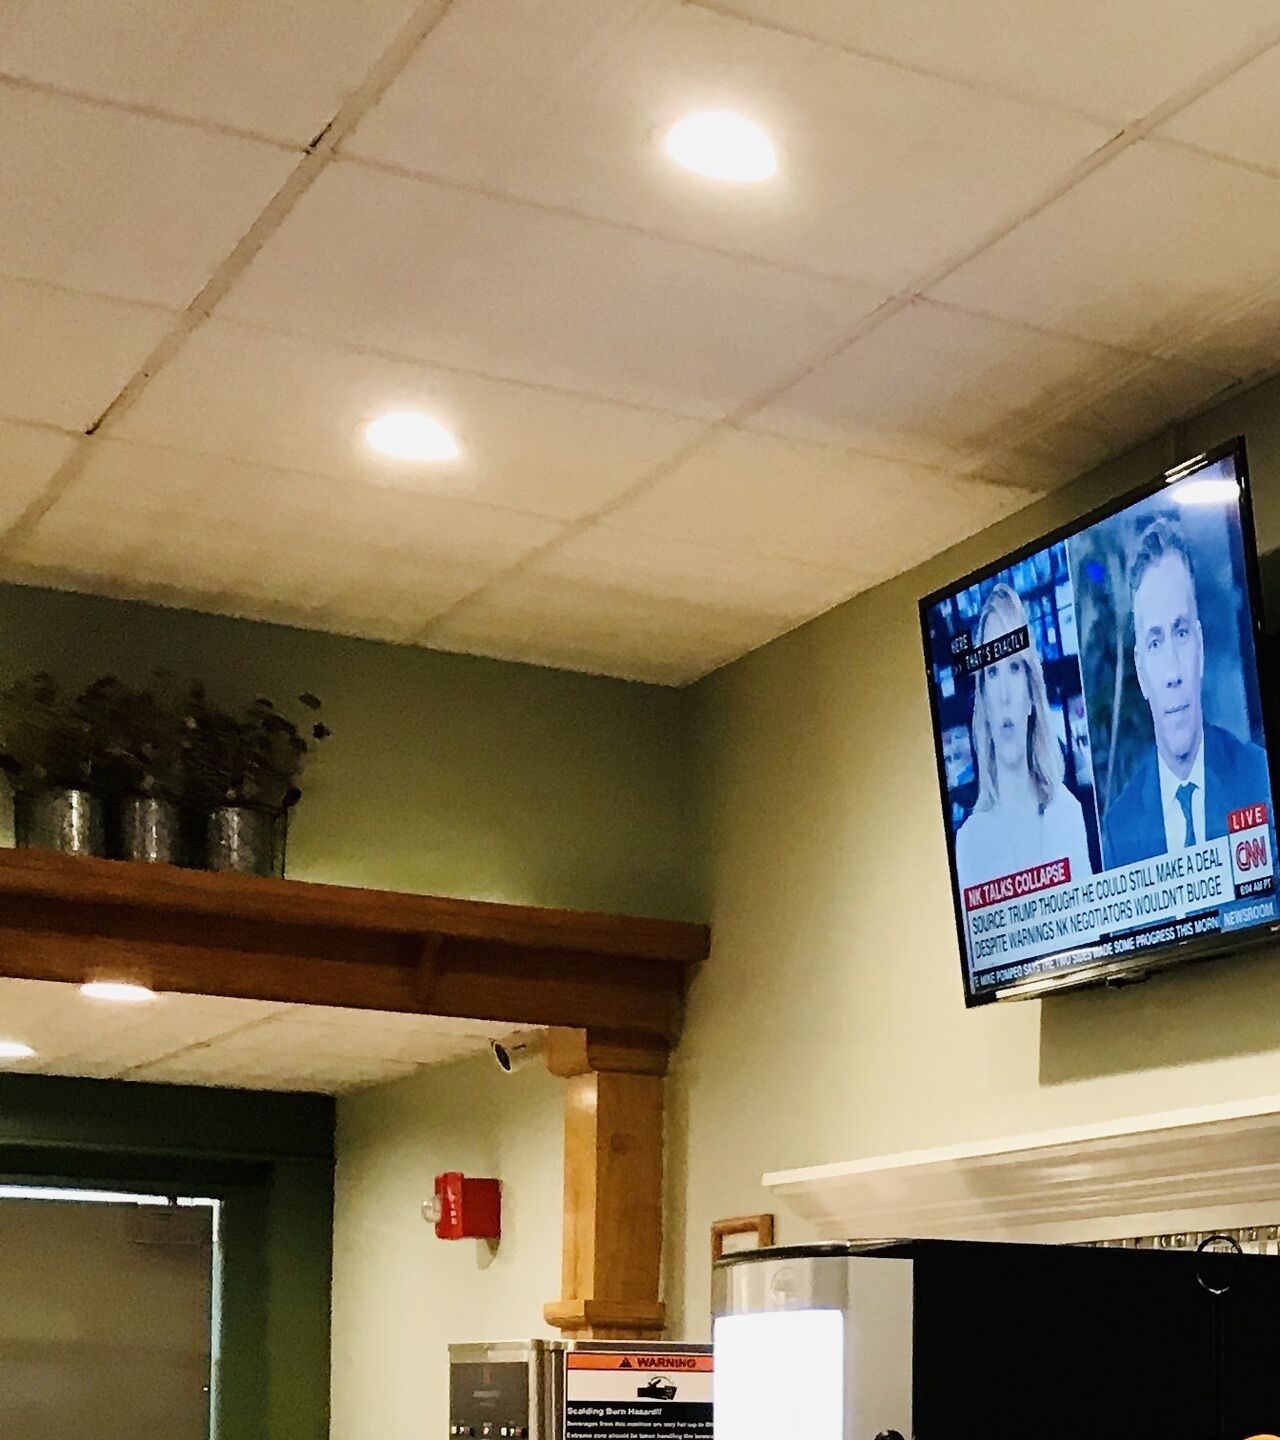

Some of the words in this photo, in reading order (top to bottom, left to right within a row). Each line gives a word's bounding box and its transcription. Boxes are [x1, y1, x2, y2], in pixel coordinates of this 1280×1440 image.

[1231, 807, 1263, 830] LIVE
[1236, 836, 1267, 871] CNN
[968, 887, 982, 907] NK
[983, 878, 1014, 900] TALKS
[1015, 862, 1066, 894] COLLAPSE
[1008, 900, 1038, 925] TRUMP
[1038, 888, 1080, 915] THOUGHT
[1082, 884, 1095, 904] HE
[1096, 875, 1128, 900] COULD
[1129, 867, 1155, 891] STILL
[1156, 858, 1185, 882] MAKE
[1187, 855, 1195, 874] A
[1195, 847, 1223, 872] DEAL
[974, 933, 1008, 959] DESPITE
[1008, 920, 1055, 949] WARNINGS
[1055, 917, 1071, 937] NK
[1070, 899, 1133, 933] NEGOTIATORS
[1134, 885, 1184, 916] WOULDN'T
[1187, 875, 1222, 903] BUDGE
[1223, 902, 1274, 928] NEWSROOM
[980, 971, 997, 986] MIKE
[997, 965, 1023, 982] POMPEO
[1023, 960, 1041, 976] SAYS
[1041, 957, 1055, 971] THE
[1055, 954, 1071, 968] TWO
[1071, 949, 1092, 964] SIDES
[1093, 943, 1113, 958] MADE
[1114, 937, 1135, 954] SOME
[1135, 926, 1175, 949] PROGRESS
[1176, 921, 1194, 938] THIS
[637, 1357, 697, 1369] WARNING
[567, 1406, 604, 1417] Scalding
[606, 1407, 626, 1416] Burn
